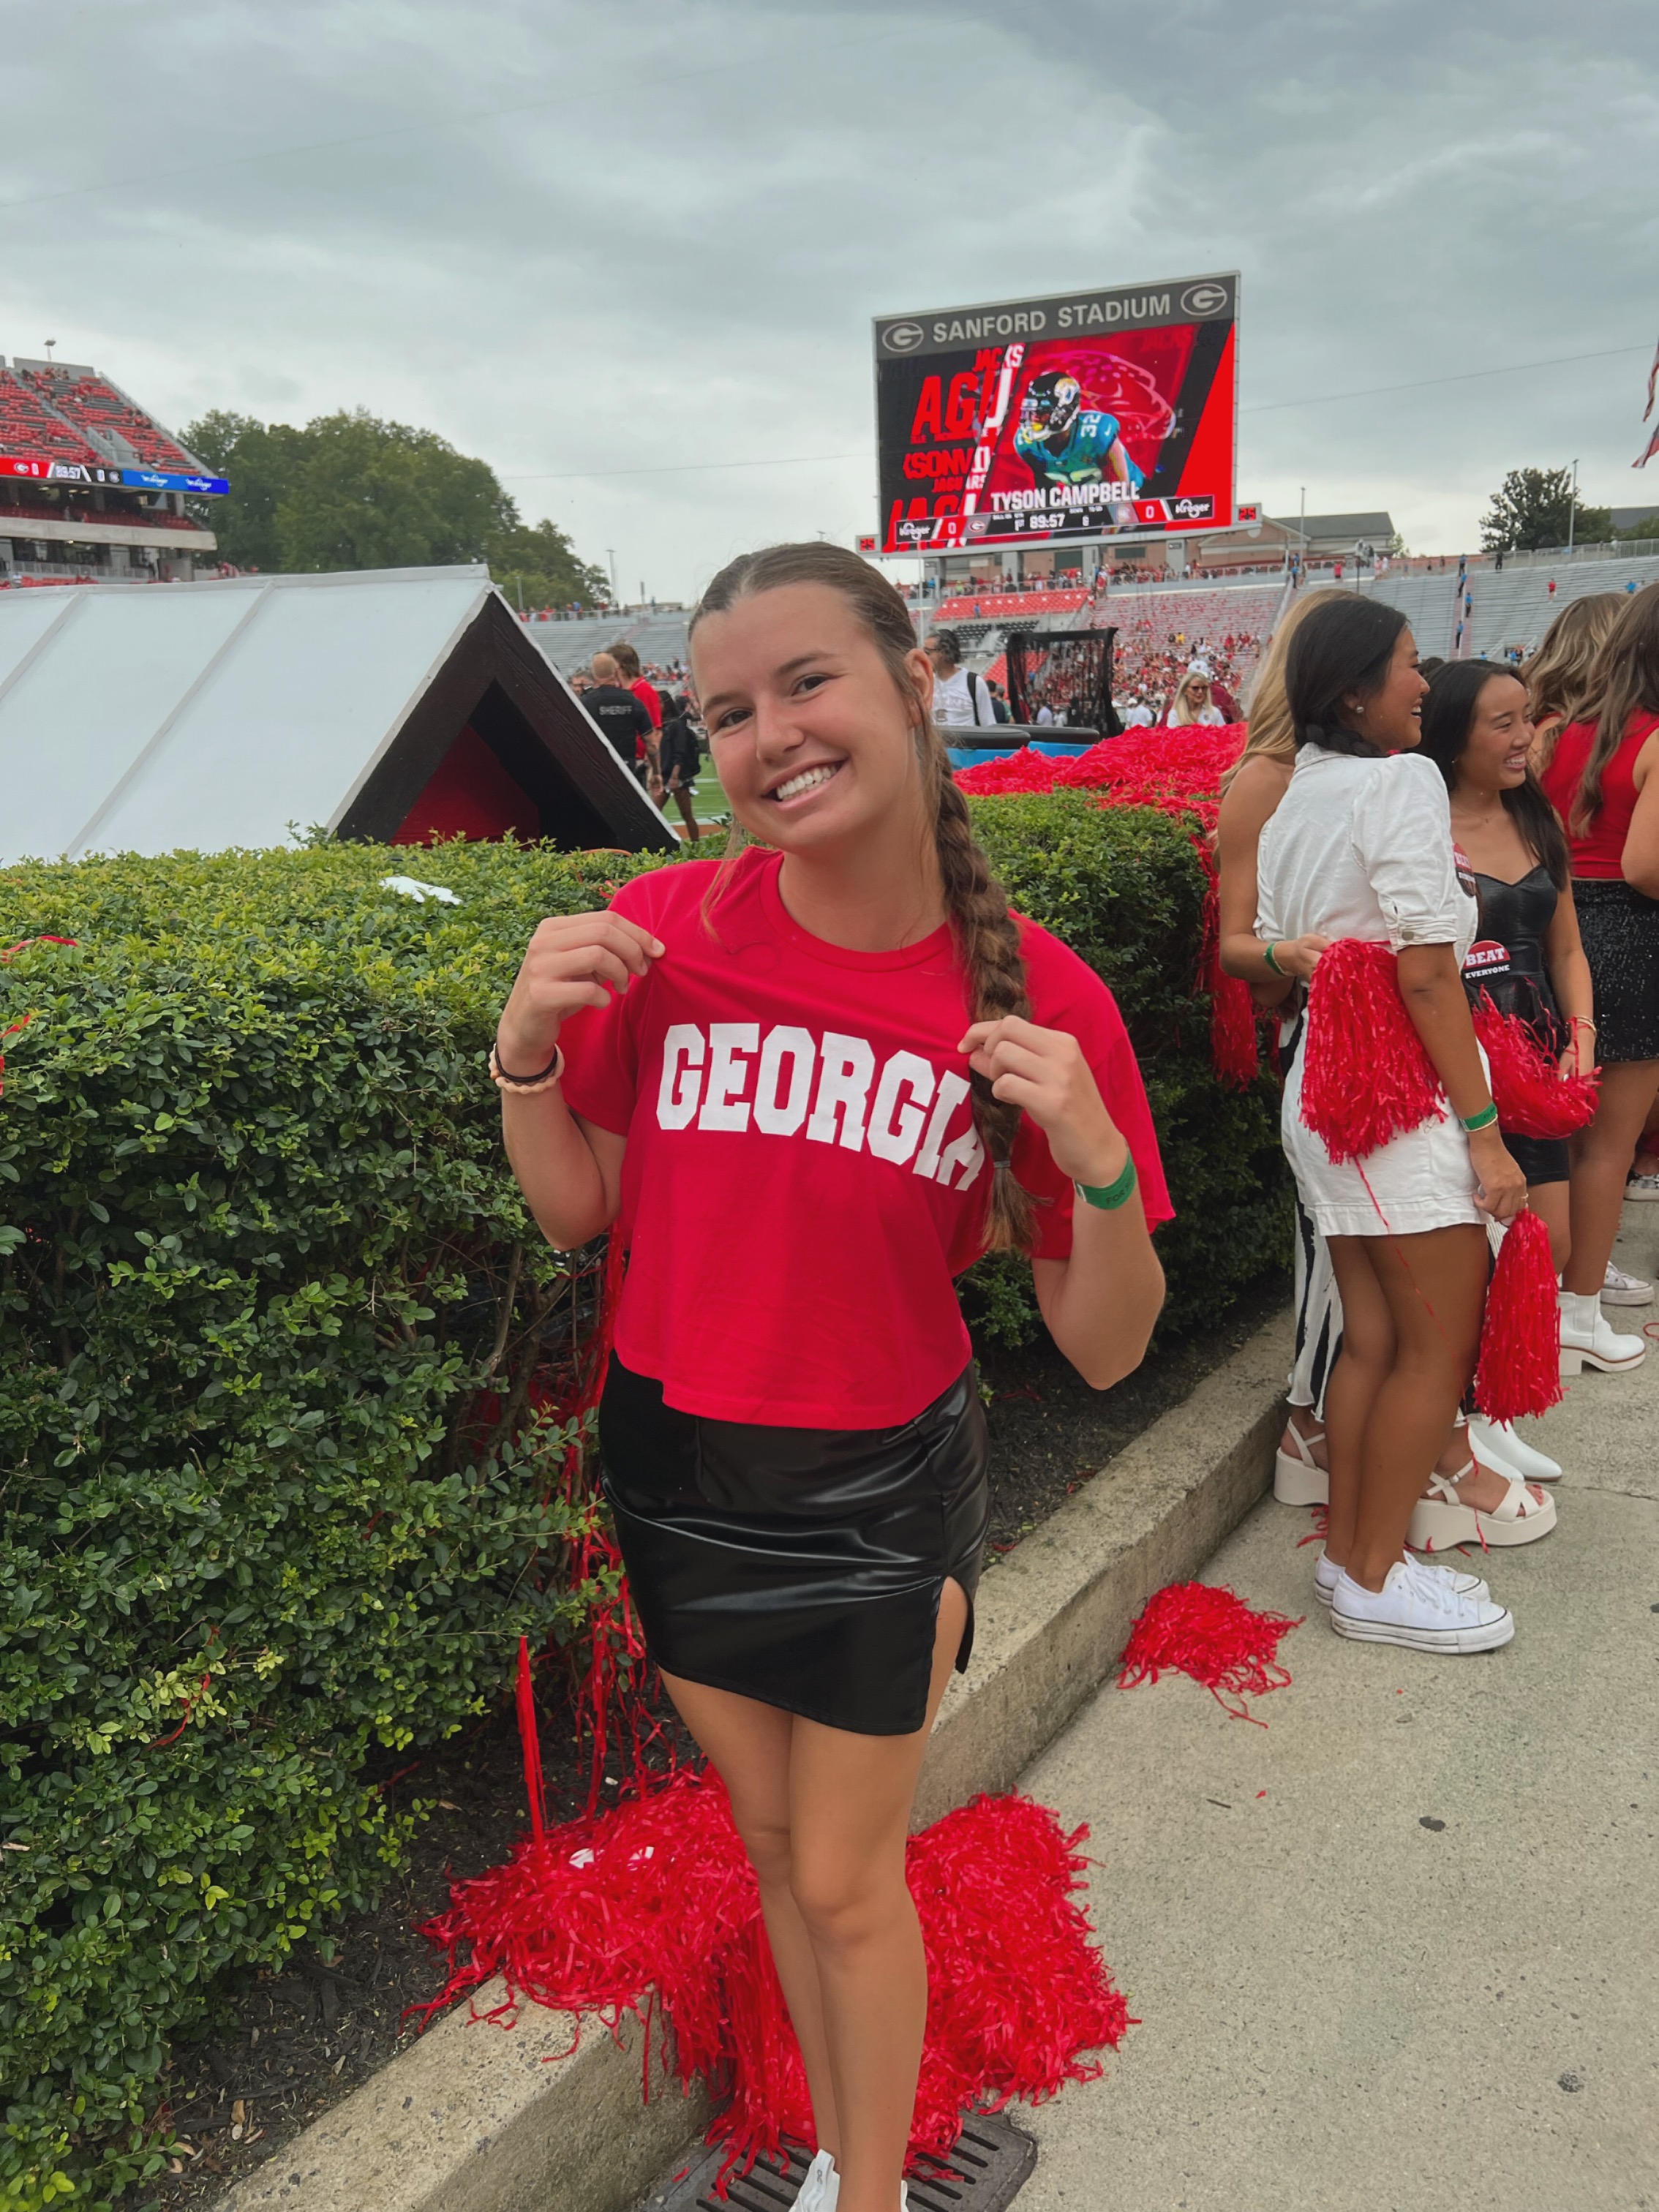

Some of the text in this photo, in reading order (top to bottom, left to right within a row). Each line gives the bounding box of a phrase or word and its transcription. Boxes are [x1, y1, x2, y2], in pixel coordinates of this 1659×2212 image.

[933, 294, 1170, 342] SANFORD STADIUM
[990, 481, 1140, 511] TYSON CAMPBELL
[1146, 505, 1154, 519] 0
[1175, 499, 1210, 518] Kroger
[1239, 507, 1256, 521] 25
[948, 522, 956, 534] 0
[1029, 514, 1065, 529] 89:57
[899, 522, 930, 540] Kroger
[599, 706, 632, 715] SHERIFF
[1466, 947, 1504, 966] BEAT
[1465, 964, 1510, 979] EVERYONE
[656, 1023, 985, 1191] GEORGIA
